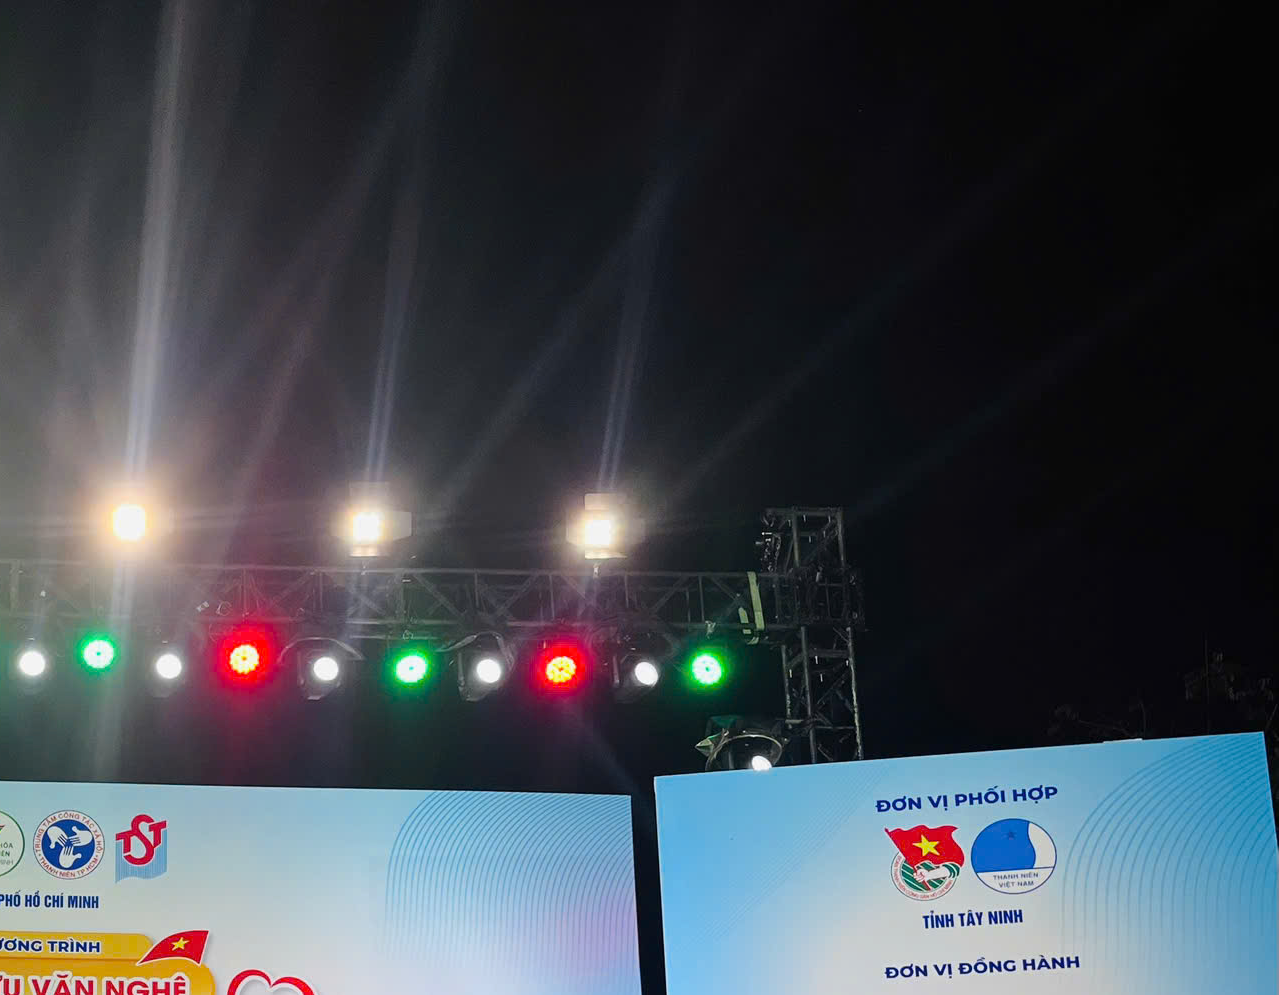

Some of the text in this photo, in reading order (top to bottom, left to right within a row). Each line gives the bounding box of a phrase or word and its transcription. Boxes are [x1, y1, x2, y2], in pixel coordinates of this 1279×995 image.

[875, 785, 1058, 813] ĐƠN VỊ PHỐI HỢP
[24, 890, 41, 908] HỒ
[44, 892, 64, 908] CHÍ
[67, 895, 99, 909] MINH
[922, 909, 1024, 929] TỈNH TÂY NINH
[49, 938, 101, 953] TRÌNH
[884, 955, 1080, 979] ĐƠN VỊ ĐỒNG HÀNH
